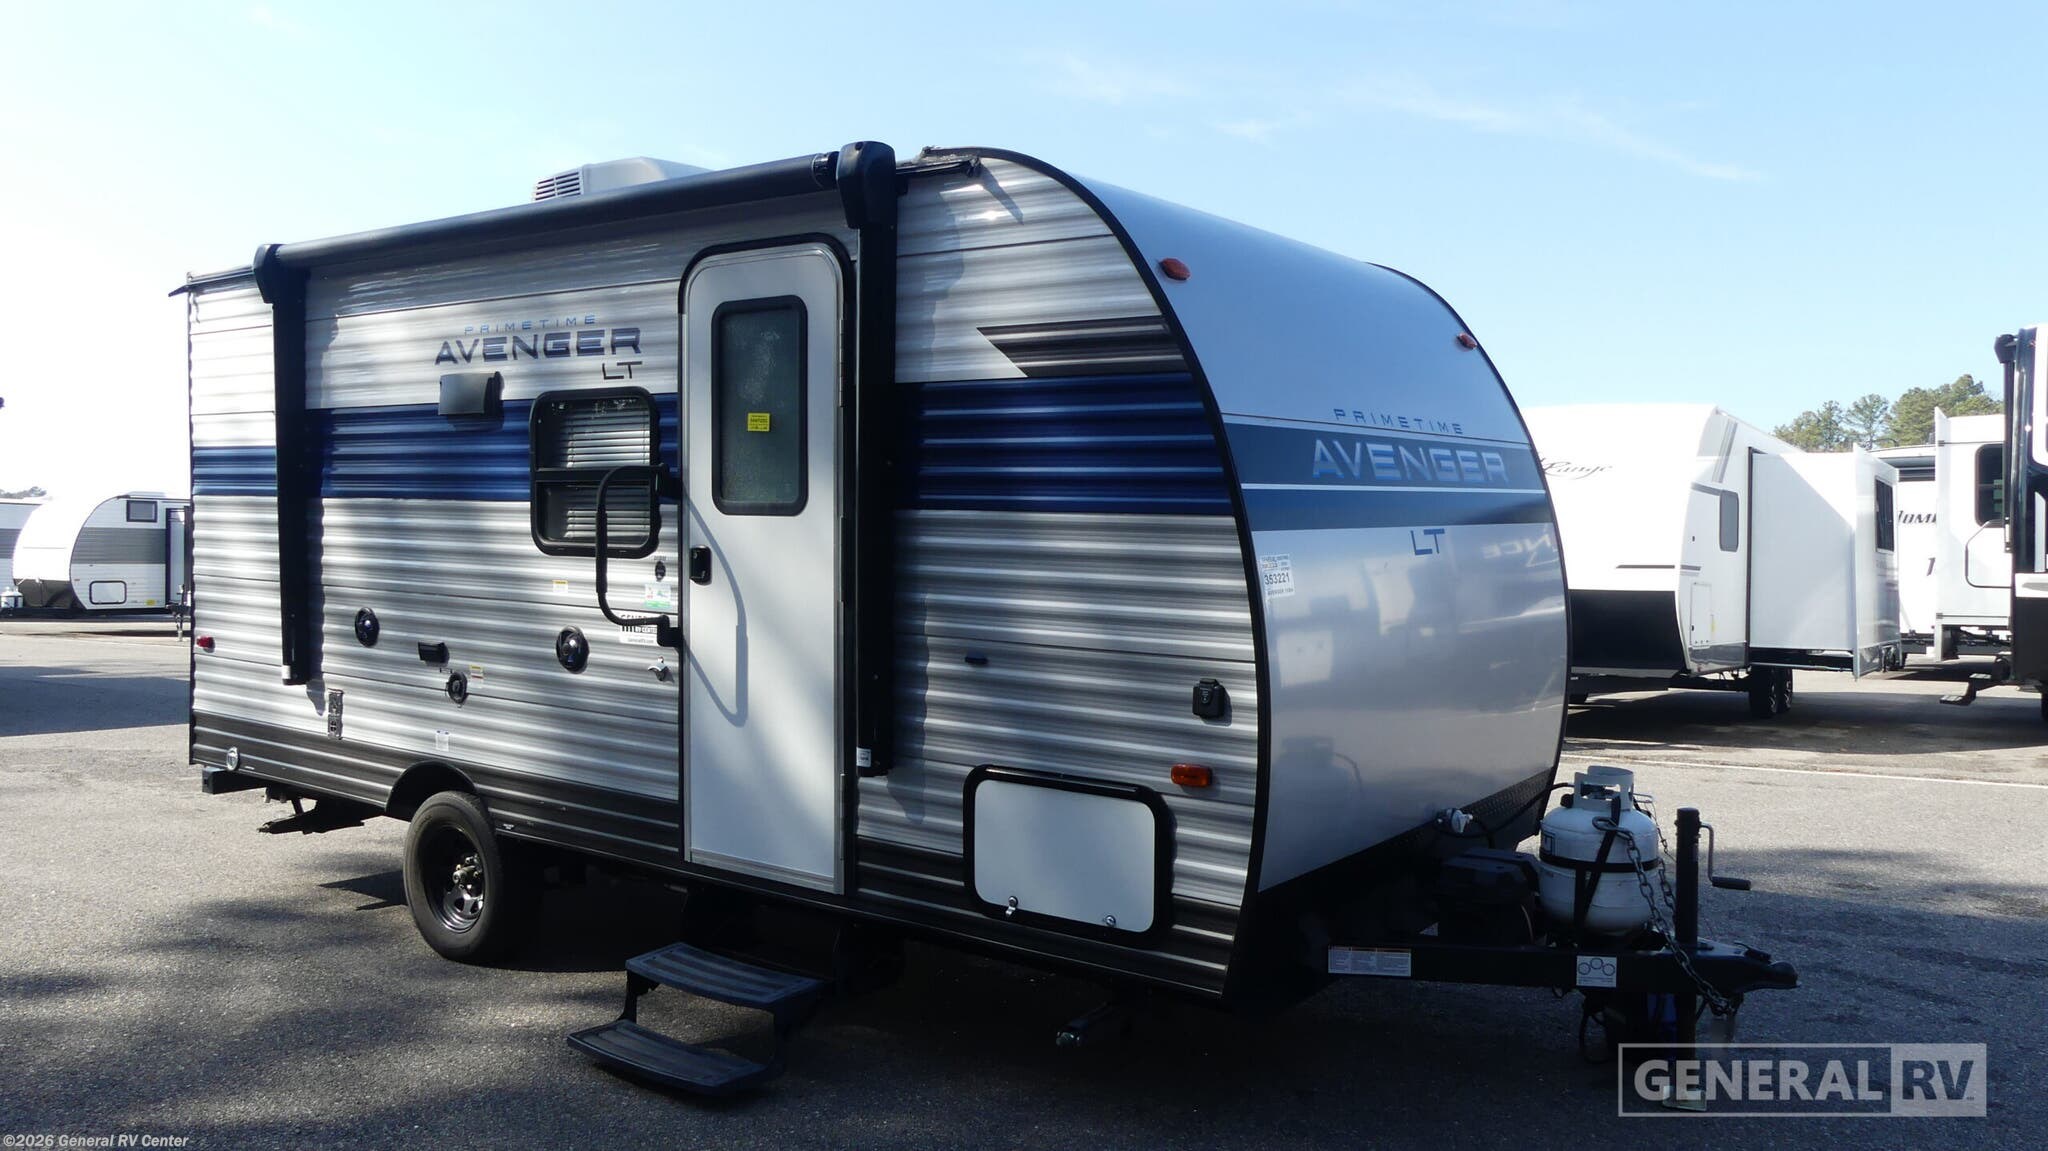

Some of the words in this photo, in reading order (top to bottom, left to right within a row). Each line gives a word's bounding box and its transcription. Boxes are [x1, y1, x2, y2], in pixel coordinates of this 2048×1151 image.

[464, 314, 596, 335] PRIMETIME
[435, 327, 642, 365] AVENGER
[602, 361, 643, 380] LT
[1333, 408, 1464, 435] PRIMETIME
[1312, 439, 1507, 483] AVENGER
[1410, 528, 1445, 556] LT
[1263, 572, 1290, 586] 353221
